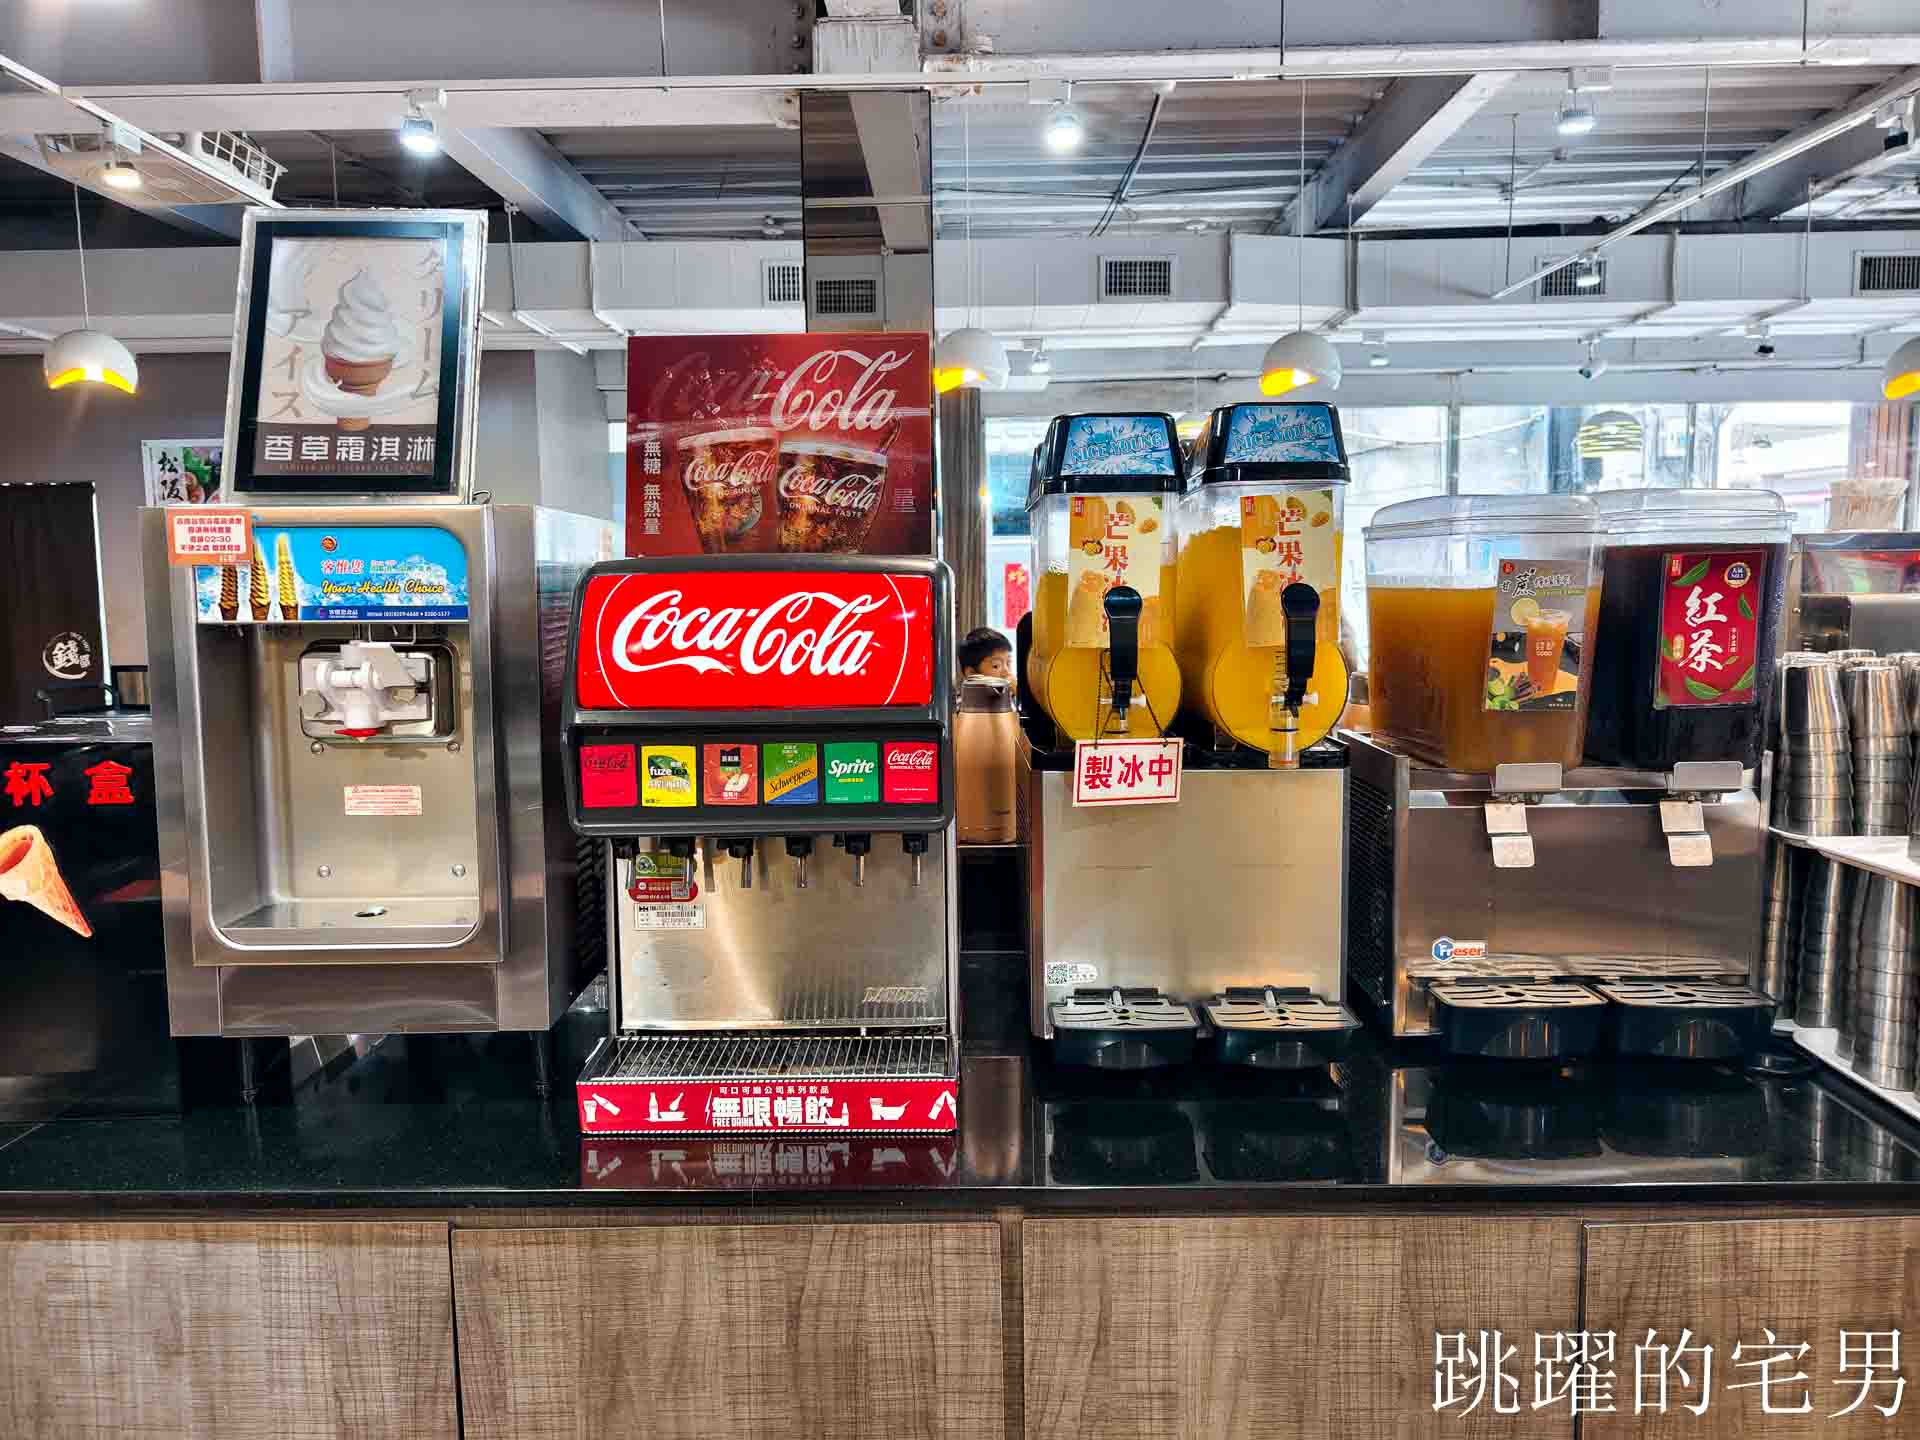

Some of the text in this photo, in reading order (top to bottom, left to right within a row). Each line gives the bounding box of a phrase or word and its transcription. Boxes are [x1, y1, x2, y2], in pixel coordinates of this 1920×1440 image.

[263, 434, 436, 462] 香草霜淇淋
[684, 449, 777, 491] Coca-Cola
[642, 440, 662, 536] 無糖 無熱量
[778, 464, 882, 510] Coca-Cola
[834, 509, 863, 519] TASTE
[321, 579, 444, 595] Your Health Choice
[611, 589, 891, 677] Coca-Cola
[1678, 585, 1728, 673] 紅茶
[828, 758, 875, 778] Sprite
[887, 749, 935, 766] Coca-Cola
[1083, 752, 1174, 791] 製冰中
[769, 767, 815, 794] Schweppes
[711, 1096, 840, 1127] 無限暢飲
[712, 1117, 755, 1127] FREE DRINK
